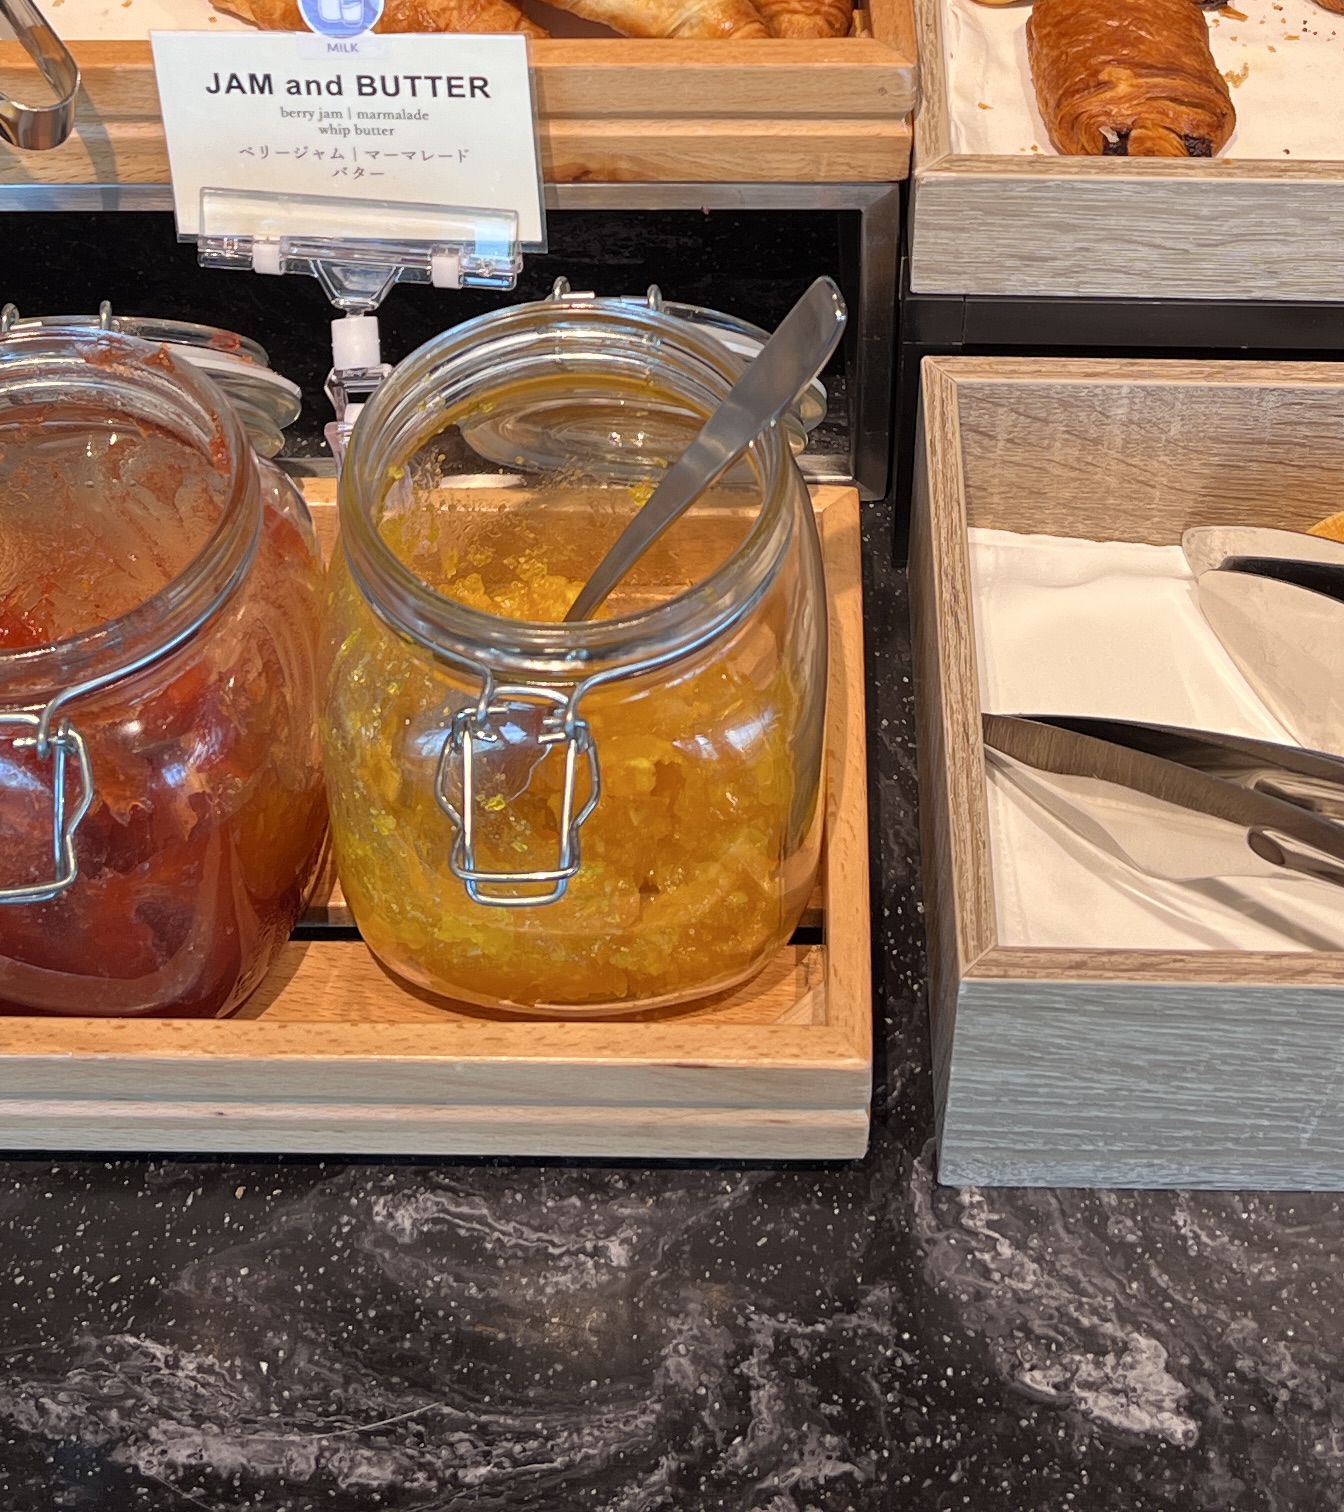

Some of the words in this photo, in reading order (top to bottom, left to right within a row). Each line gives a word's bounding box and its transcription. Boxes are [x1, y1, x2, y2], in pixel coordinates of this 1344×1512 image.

[327, 42, 360, 54] MILK
[206, 71, 274, 96] JAM
[285, 74, 344, 97] and
[356, 75, 492, 99] BUTTER
[280, 106, 315, 122] berry
[316, 107, 343, 122] jam
[356, 108, 430, 121] marmalade
[318, 123, 351, 138] whip
[354, 123, 395, 137] butter
[239, 145, 344, 162] ベリージャム
[364, 147, 470, 164] マーマレード
[330, 166, 385, 181] バター
